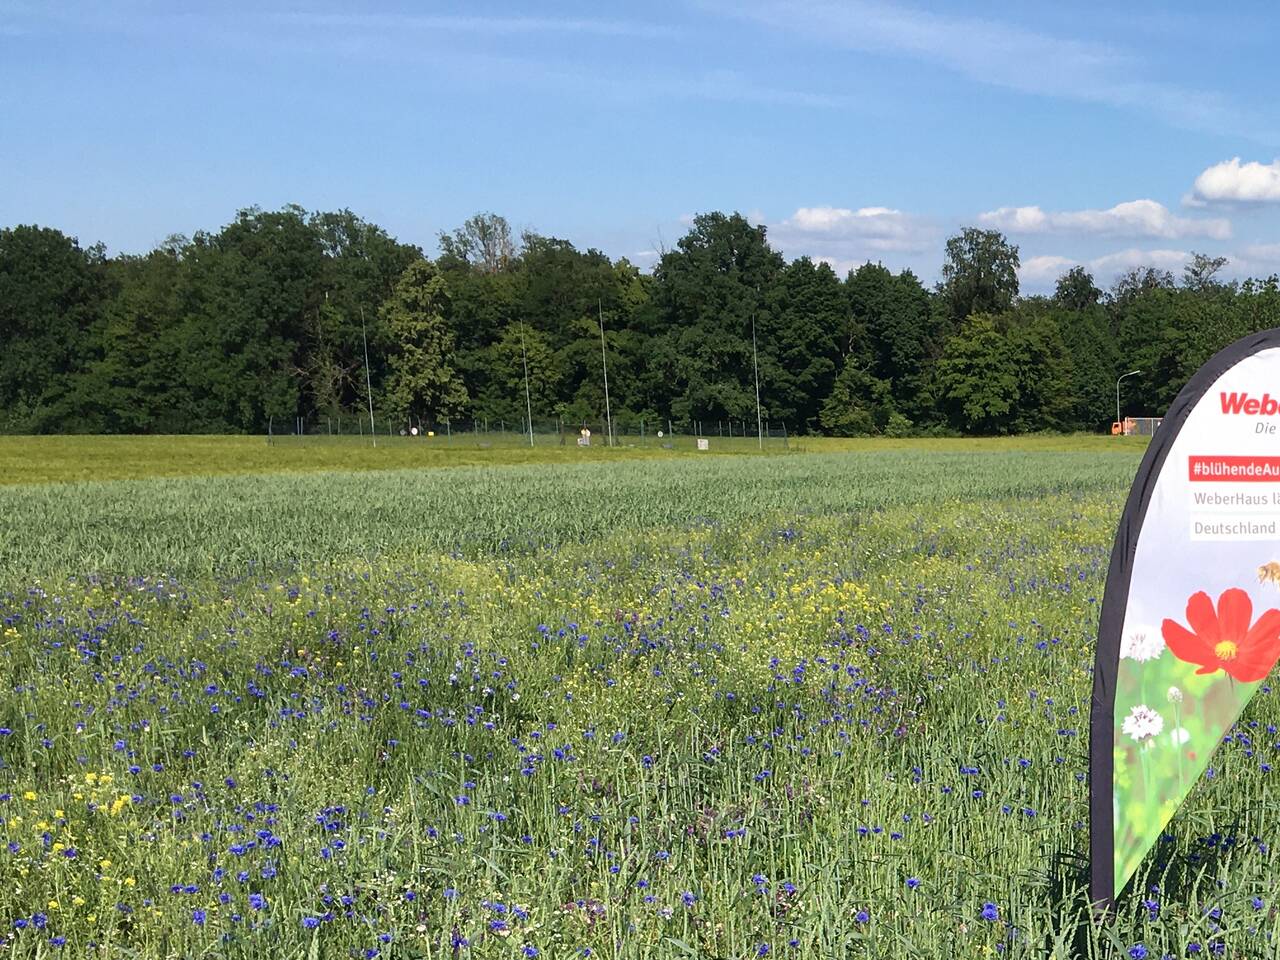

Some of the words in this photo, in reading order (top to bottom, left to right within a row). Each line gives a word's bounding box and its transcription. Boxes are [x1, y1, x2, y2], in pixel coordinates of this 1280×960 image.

[1255, 422, 1276, 435] Die
[1194, 492, 1268, 505] WeberHaus
[1194, 521, 1276, 534] Deutschland
